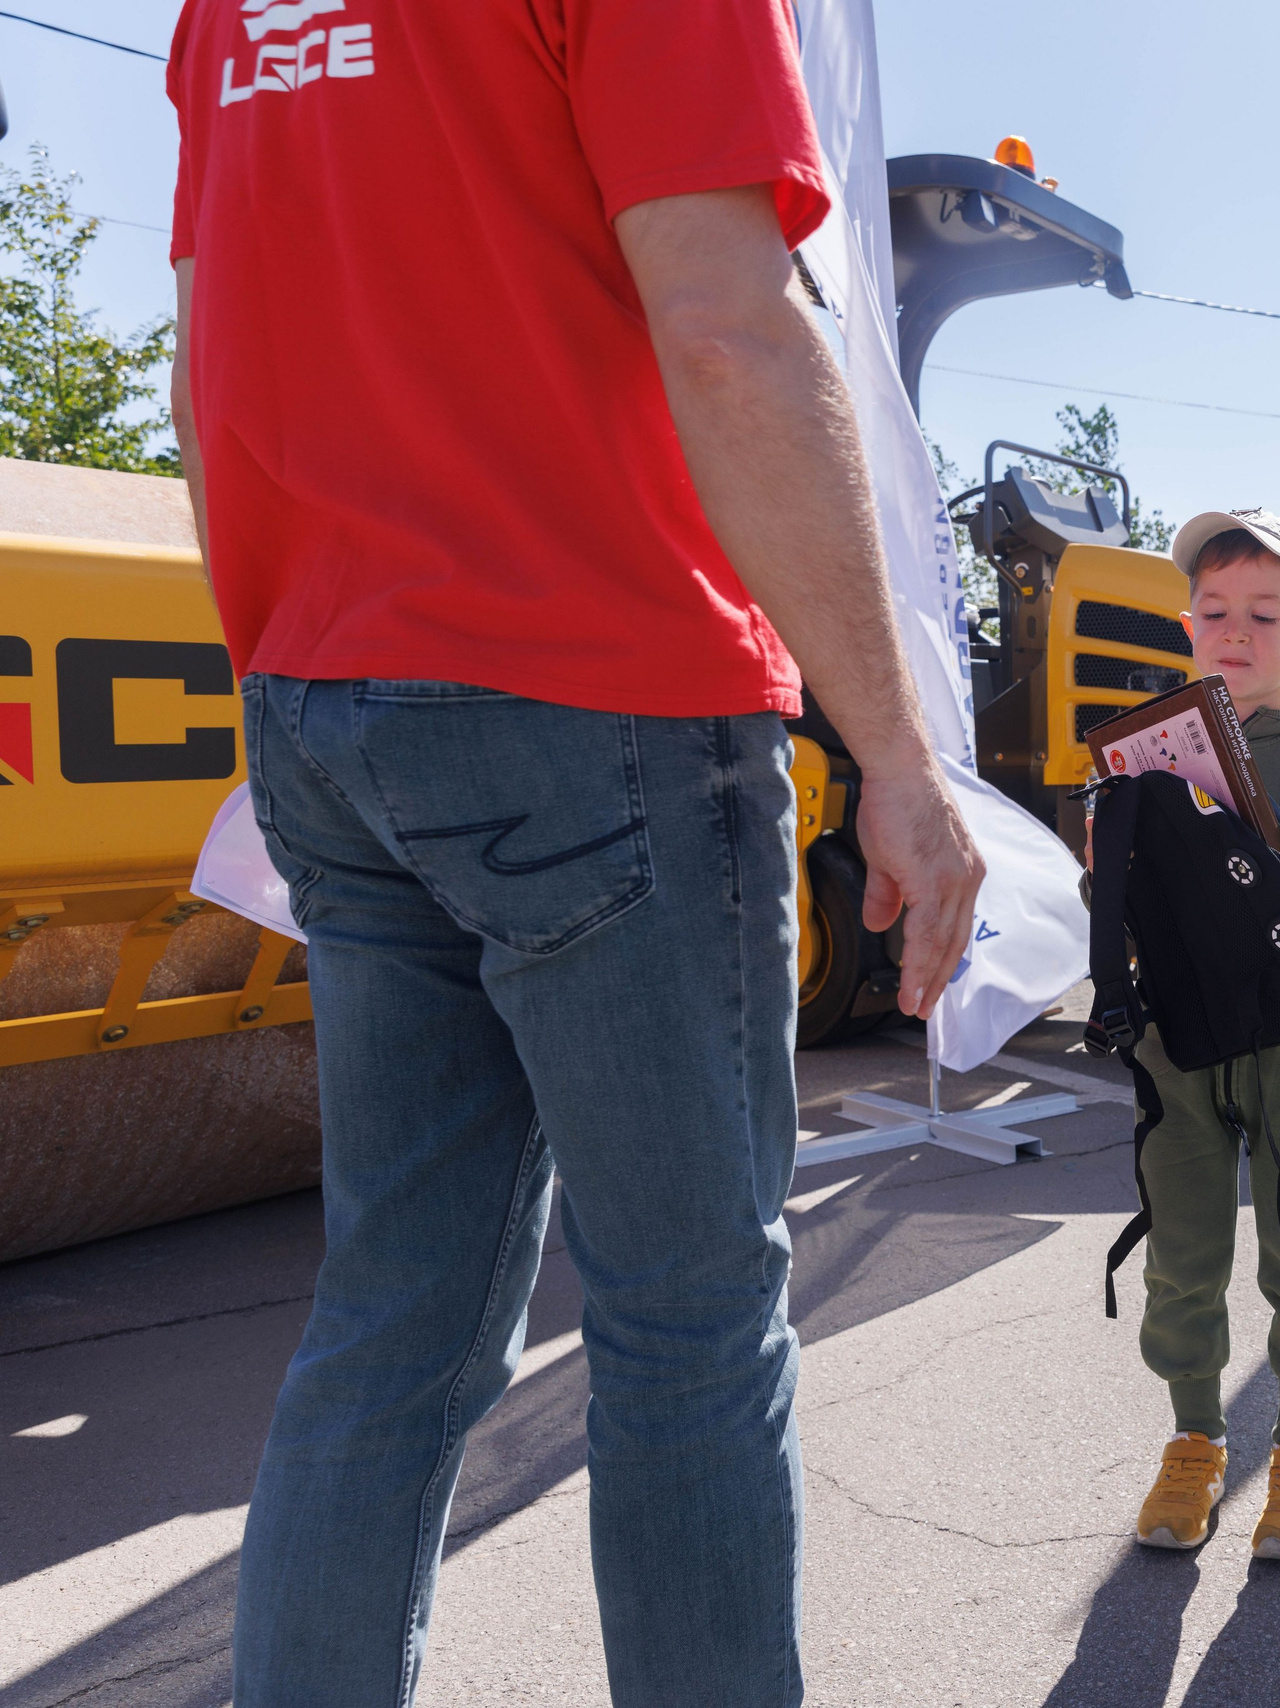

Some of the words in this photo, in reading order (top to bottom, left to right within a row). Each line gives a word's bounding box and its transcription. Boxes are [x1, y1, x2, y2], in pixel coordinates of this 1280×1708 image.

[219, 23, 375, 108] LGCE
[1211, 689, 1235, 739] настольная
[1231, 739, 1257, 798] игра-ходилка
[1217, 685, 1228, 705] НА
[1225, 706, 1253, 761] СТРОЙКЕ
